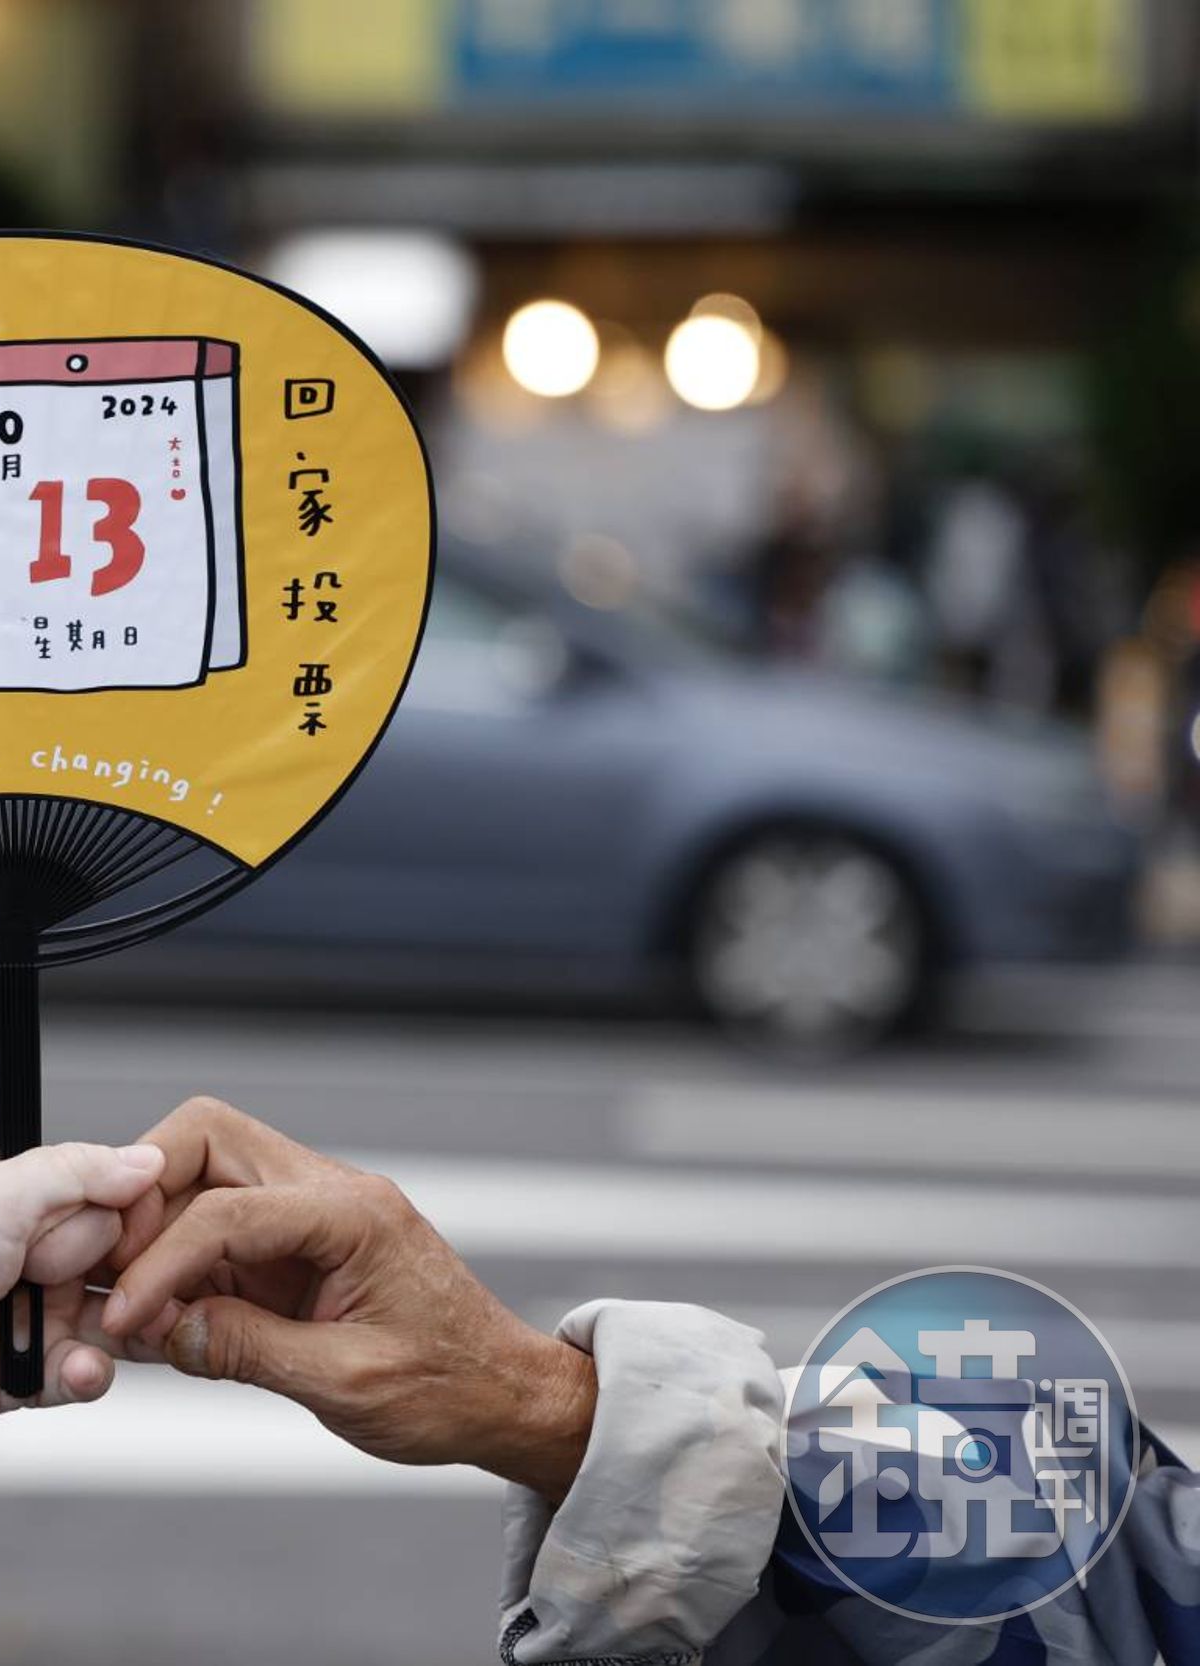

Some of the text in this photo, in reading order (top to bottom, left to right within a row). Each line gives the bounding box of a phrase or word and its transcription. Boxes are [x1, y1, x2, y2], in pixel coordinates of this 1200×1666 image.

[101, 395, 178, 419] 2024
[1, 453, 22, 481] 月
[28, 477, 146, 598] 13
[282, 379, 343, 737] 回家投票
[33, 616, 138, 659] 星期日
